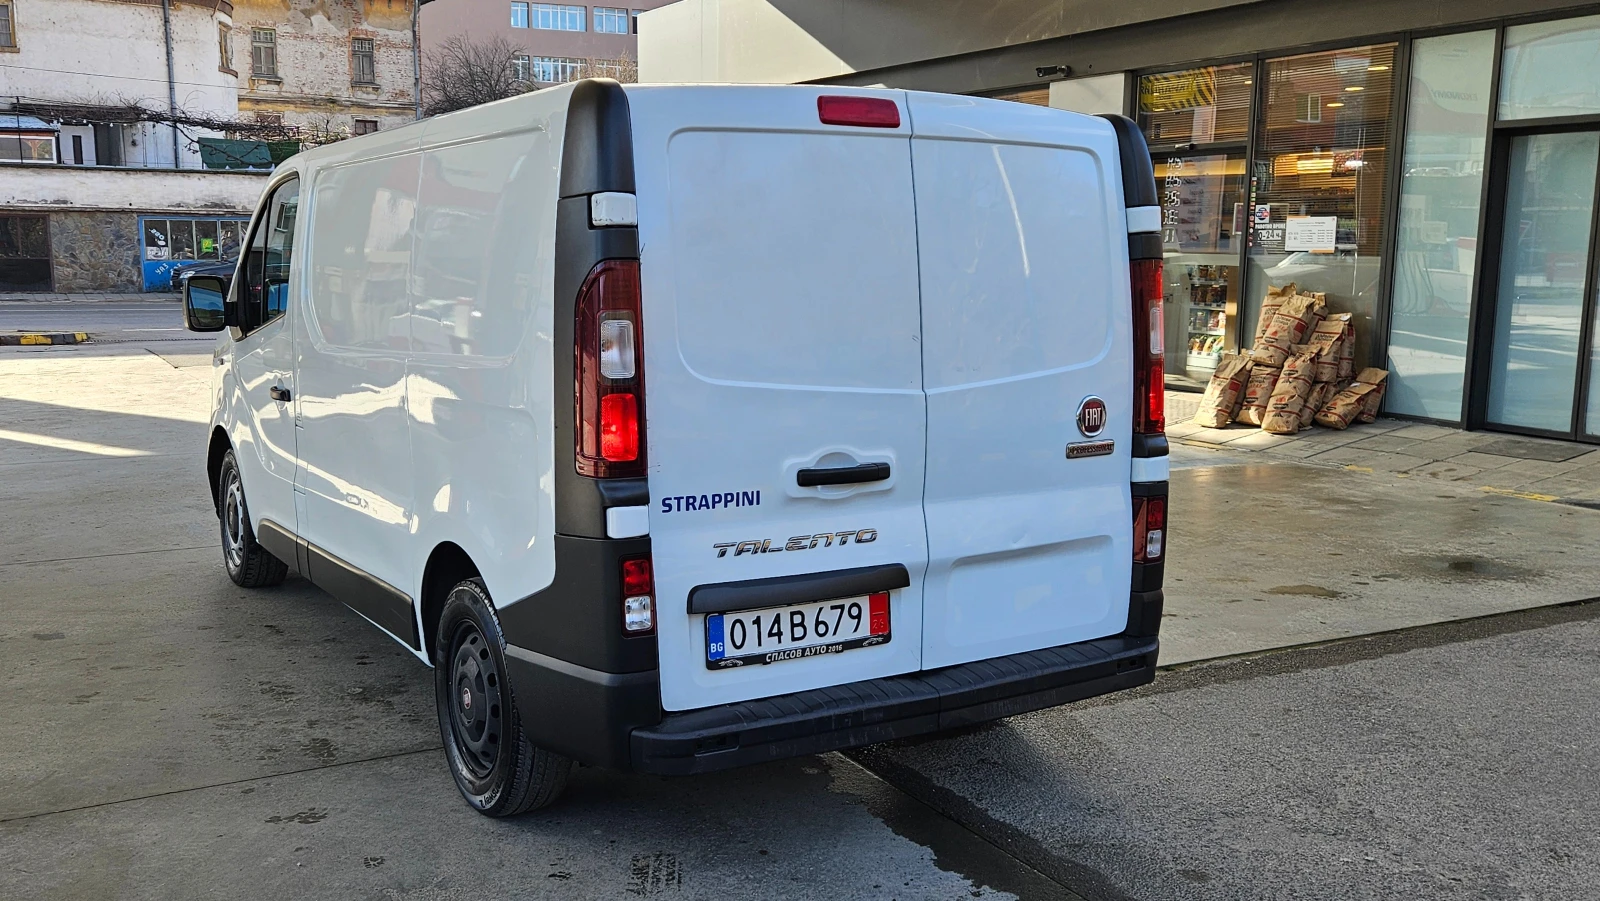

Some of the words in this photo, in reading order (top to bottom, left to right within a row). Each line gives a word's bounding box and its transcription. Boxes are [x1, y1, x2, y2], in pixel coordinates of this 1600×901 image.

[1085, 408, 1101, 426] FIAT
[661, 490, 761, 514] STRAPPINI
[713, 528, 878, 558] TALENTO
[710, 642, 724, 653] BG
[766, 648, 802, 662] СПАСОВ
[804, 645, 827, 657] АУТО
[828, 644, 843, 653] 2016
